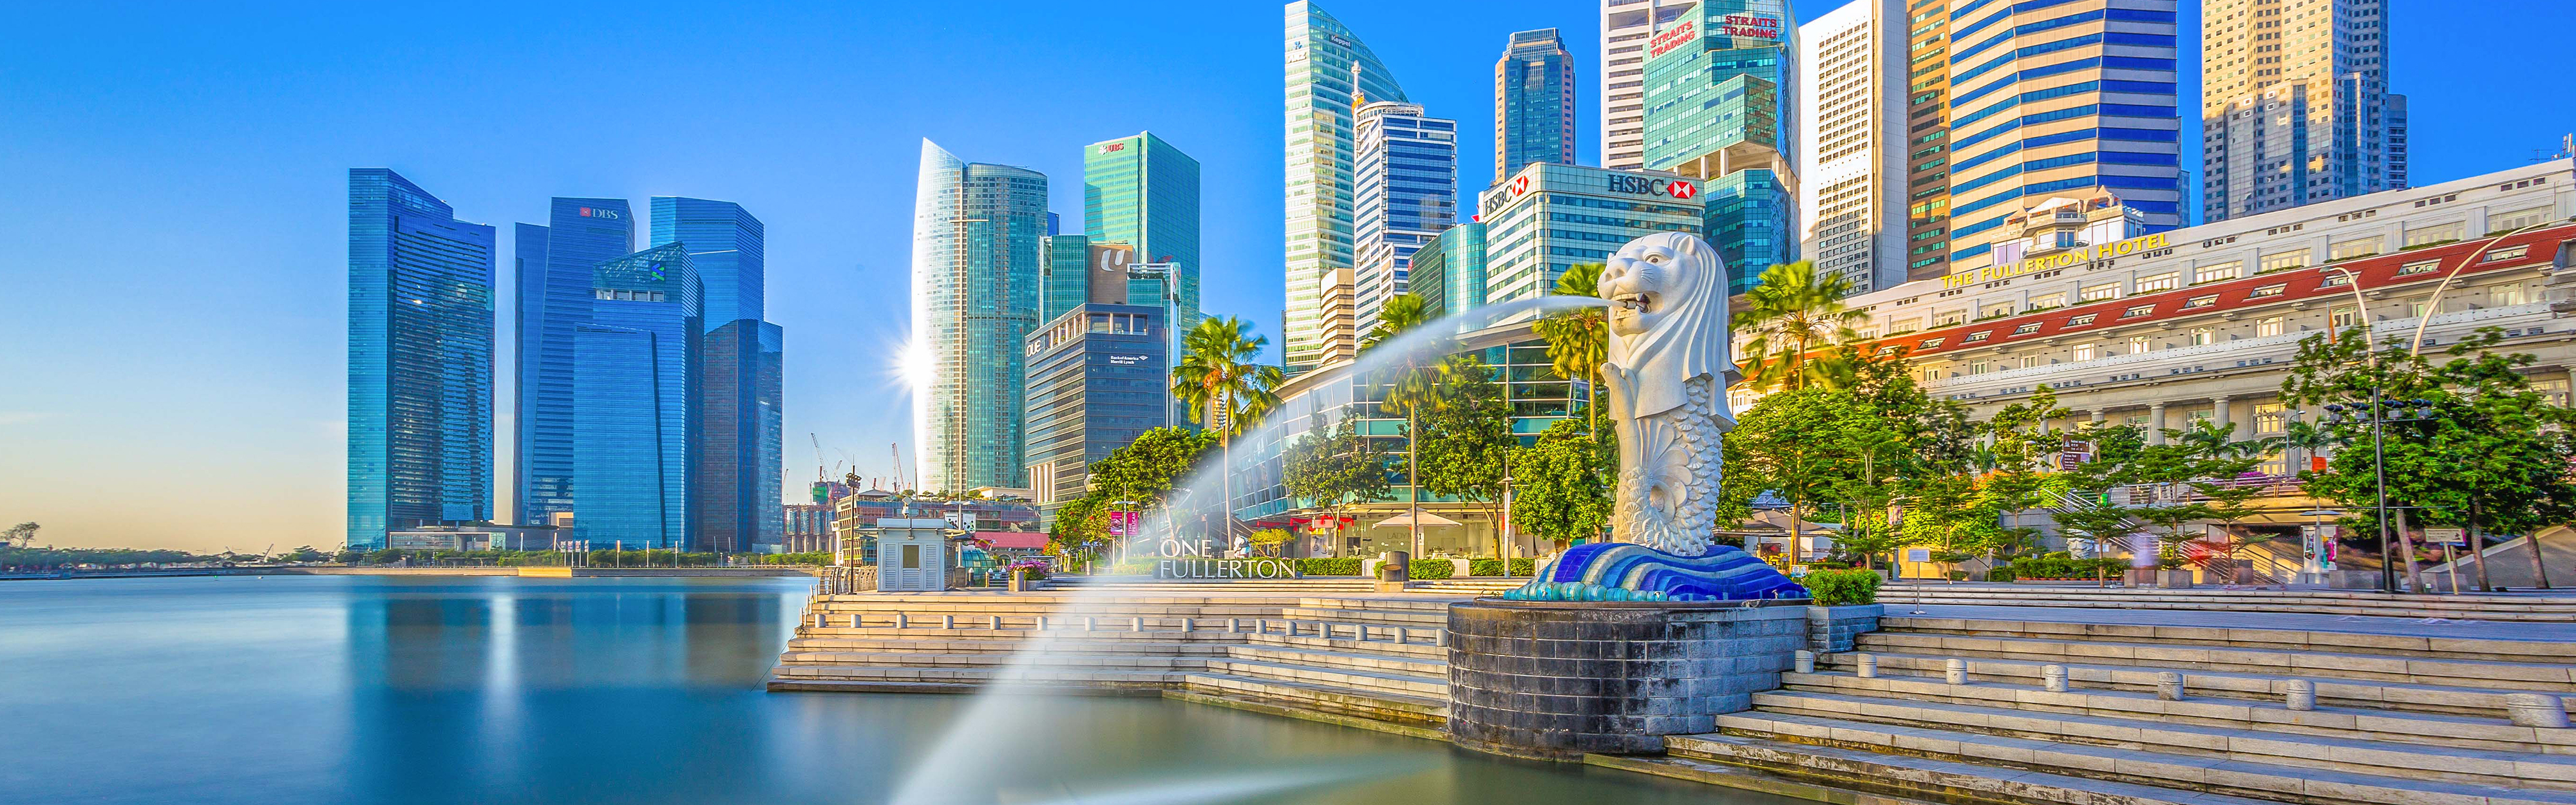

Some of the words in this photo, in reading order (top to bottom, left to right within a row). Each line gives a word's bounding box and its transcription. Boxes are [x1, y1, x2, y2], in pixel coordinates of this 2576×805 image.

[1725, 15, 1777, 28] STRAITS
[1331, 35, 1351, 47] Keppel
[1650, 20, 1693, 48] STRAITS
[1722, 26, 1777, 39] TRADING
[1650, 30, 1695, 59] TRADING
[1107, 143, 1124, 153] UBS
[1607, 173, 1665, 196] HSBC
[1483, 185, 1513, 217] HSBC
[592, 208, 618, 219] DBS
[1940, 272, 1975, 289] THE
[1981, 249, 2088, 282] FULLERTON
[2098, 233, 2170, 258] HOTEL
[1160, 539, 1212, 558] ONE
[1160, 559, 1296, 579] FULLERTON
